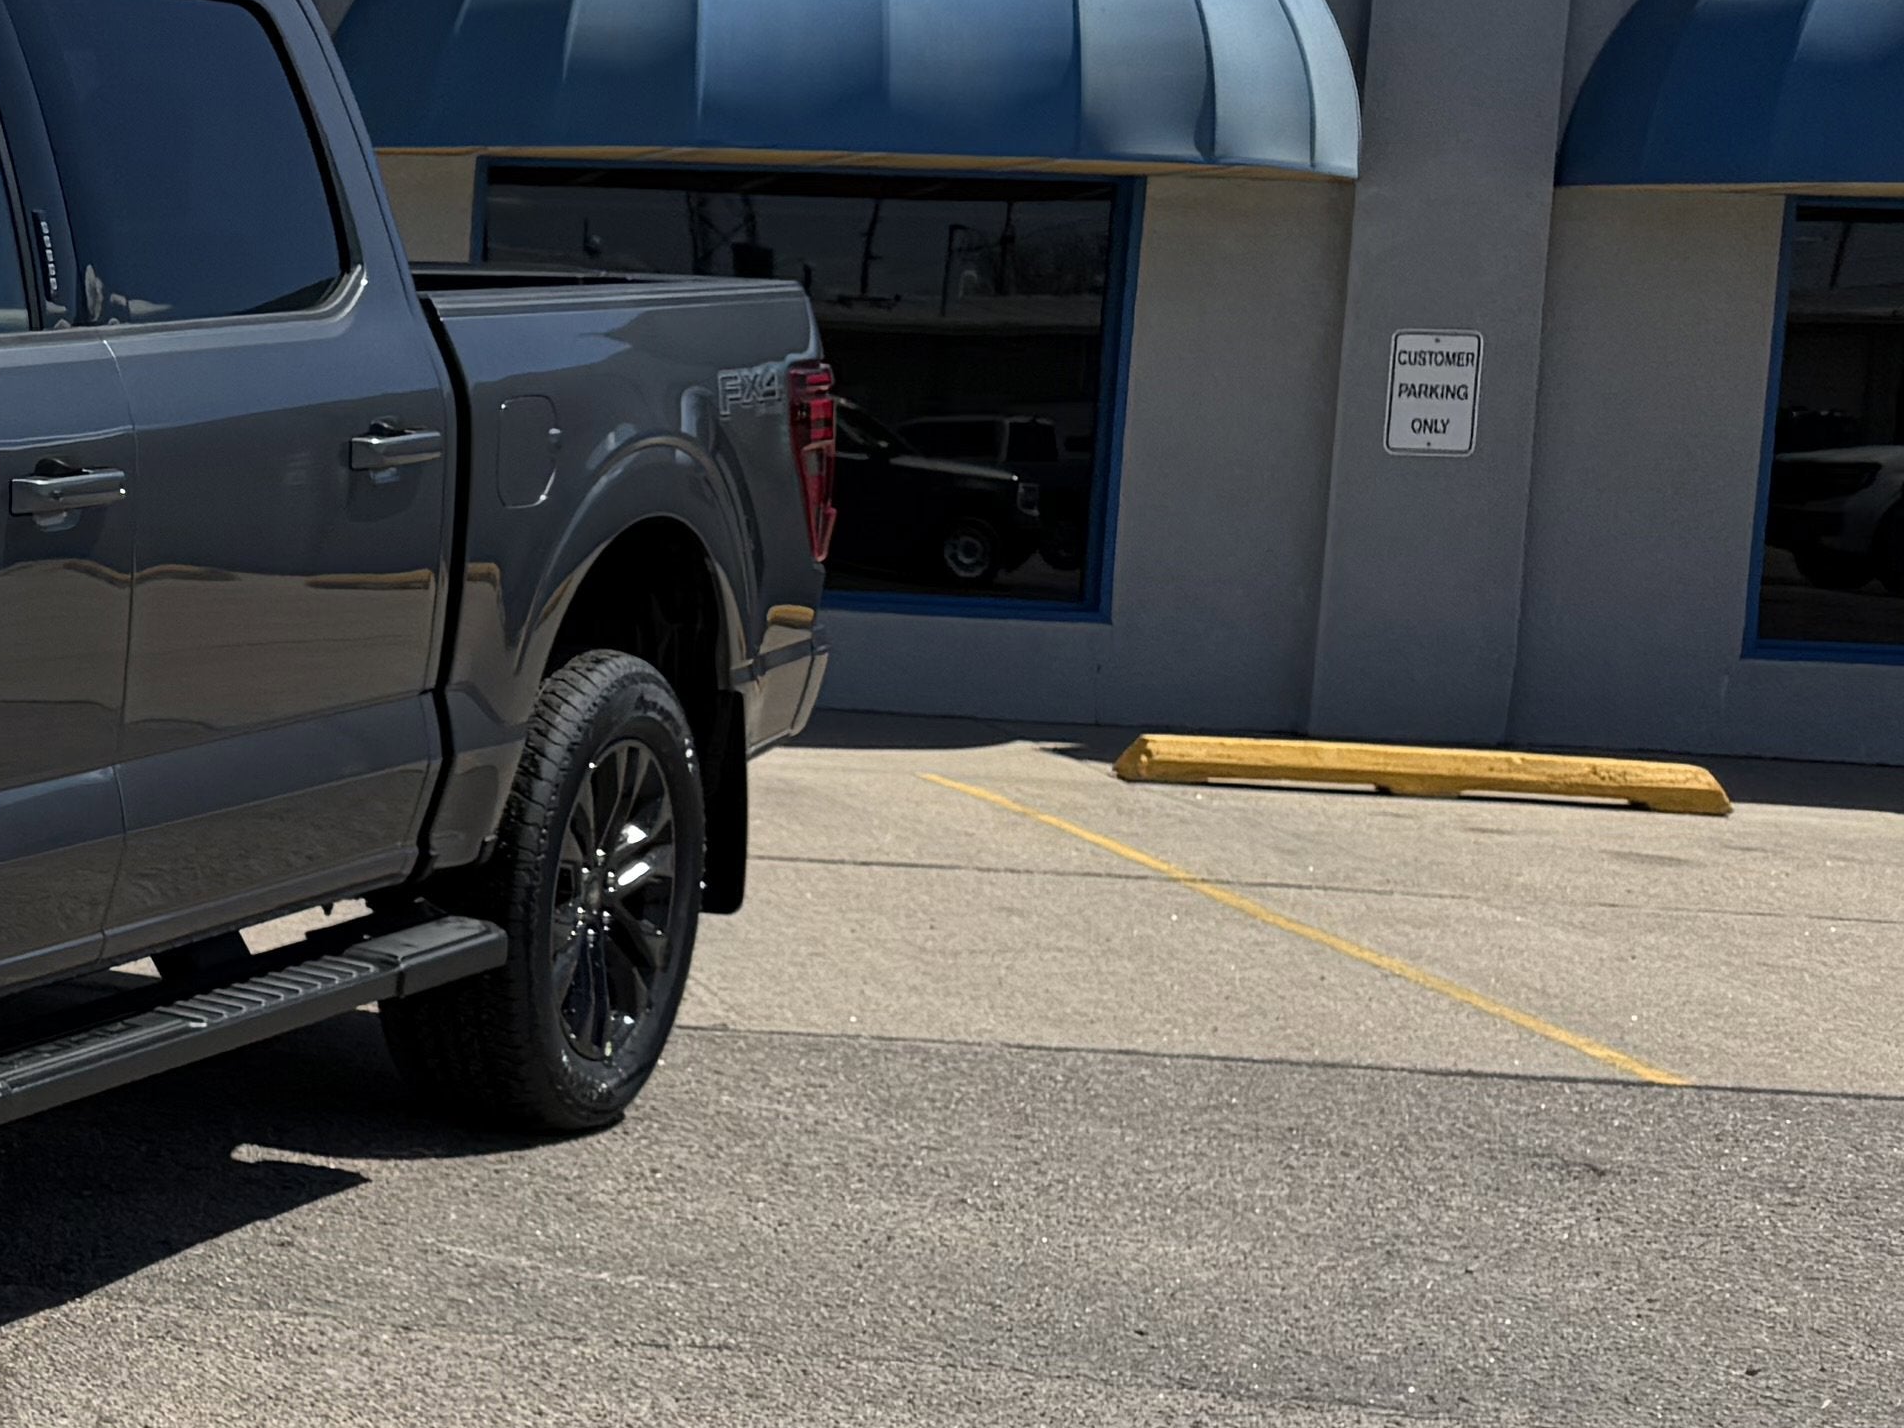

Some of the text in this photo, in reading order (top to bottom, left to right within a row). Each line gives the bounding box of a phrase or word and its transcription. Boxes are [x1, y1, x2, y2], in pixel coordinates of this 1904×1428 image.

[1397, 350, 1475, 367] CUSTOMER
[717, 365, 781, 417] FX4
[1398, 383, 1469, 400] PARKING
[1411, 418, 1450, 434] ONLY
